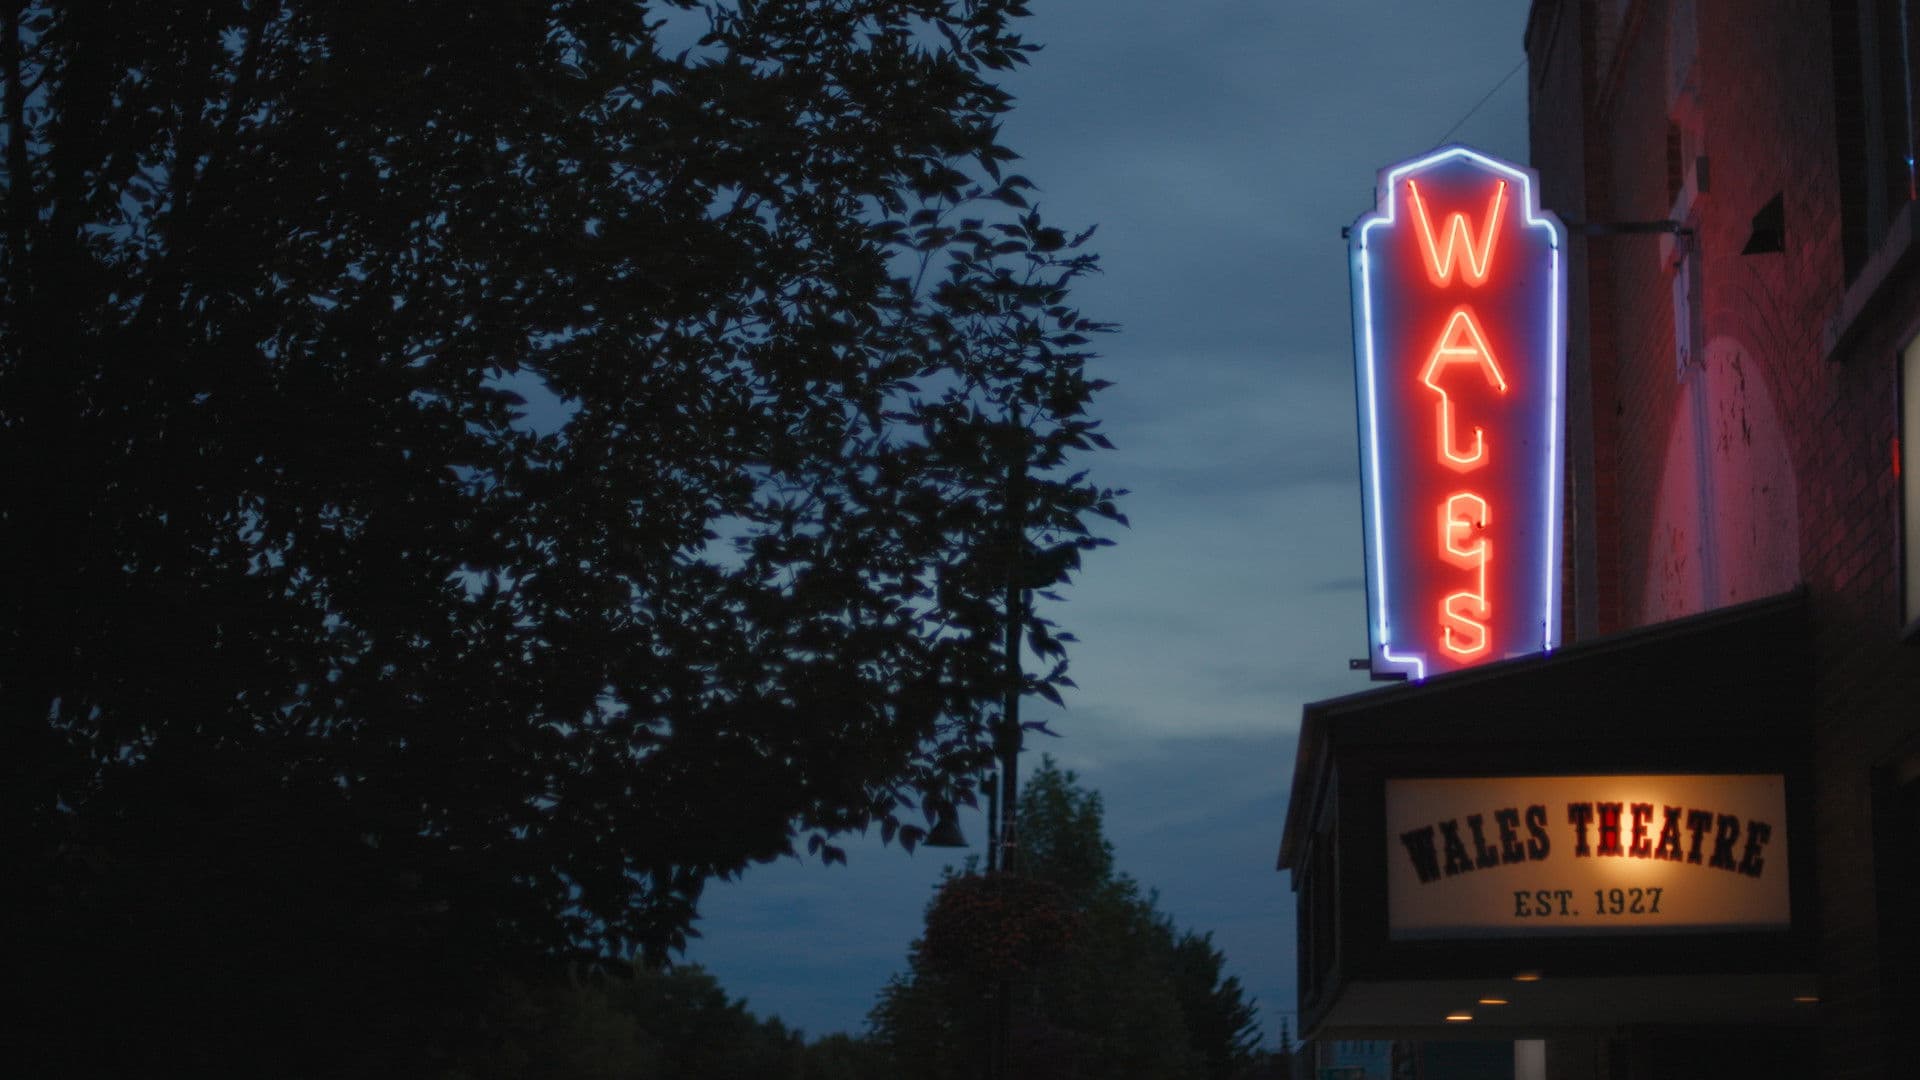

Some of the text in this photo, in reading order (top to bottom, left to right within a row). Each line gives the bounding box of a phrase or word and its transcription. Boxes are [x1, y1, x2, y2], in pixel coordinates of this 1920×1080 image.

[1406, 179, 1508, 663] WALES
[1400, 802, 1772, 884] WALES THEATRE
[1514, 887, 1664, 917] EST. 1927
